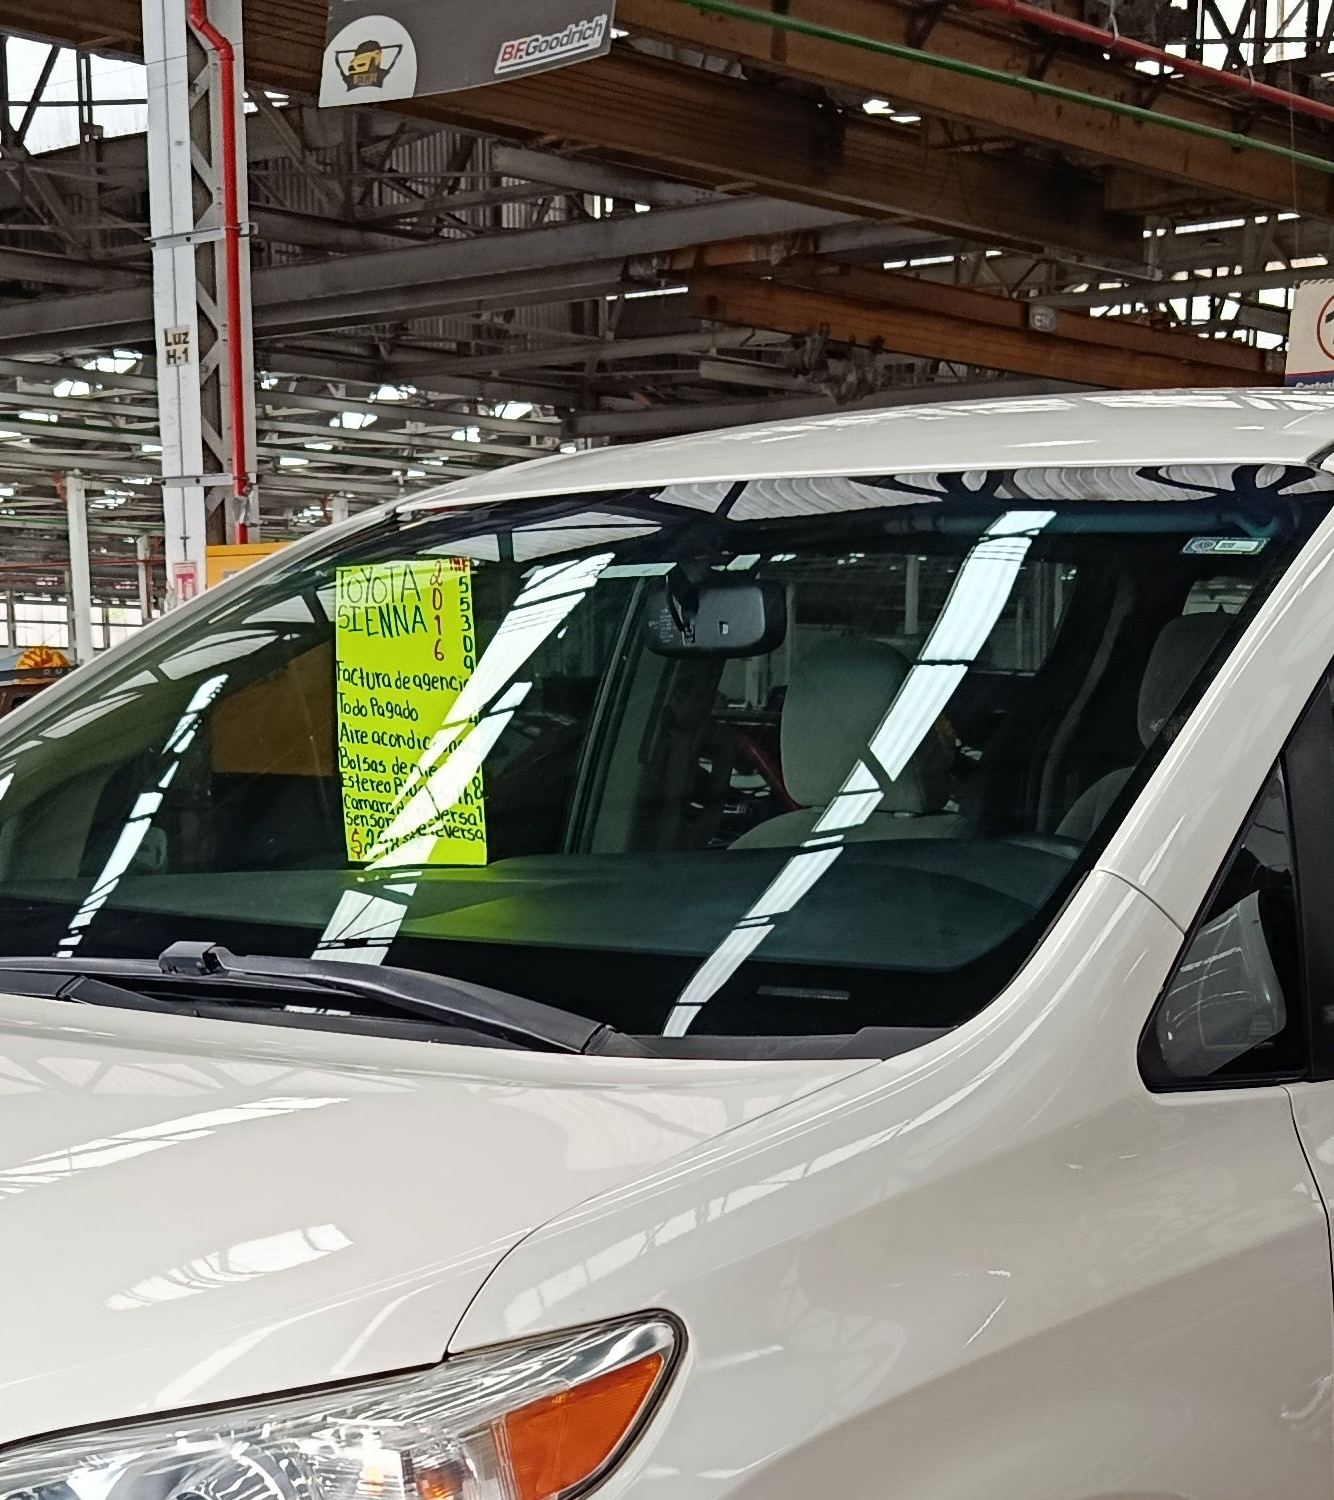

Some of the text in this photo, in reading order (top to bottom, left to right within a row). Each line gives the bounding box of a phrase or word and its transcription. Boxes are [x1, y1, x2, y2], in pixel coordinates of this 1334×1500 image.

[164, 331, 189, 346] Luz
[166, 347, 189, 364] H-1
[336, 564, 421, 604] TOYOTA
[338, 602, 428, 638] SIENNA
[430, 560, 445, 661] 2016
[337, 661, 392, 690] Factura
[395, 670, 410, 690] de
[337, 692, 418, 721] Todo Pagado
[340, 722, 368, 744] Aire
[338, 746, 386, 773] Bolsas
[392, 756, 408, 775] de
[340, 771, 391, 793] Estereo
